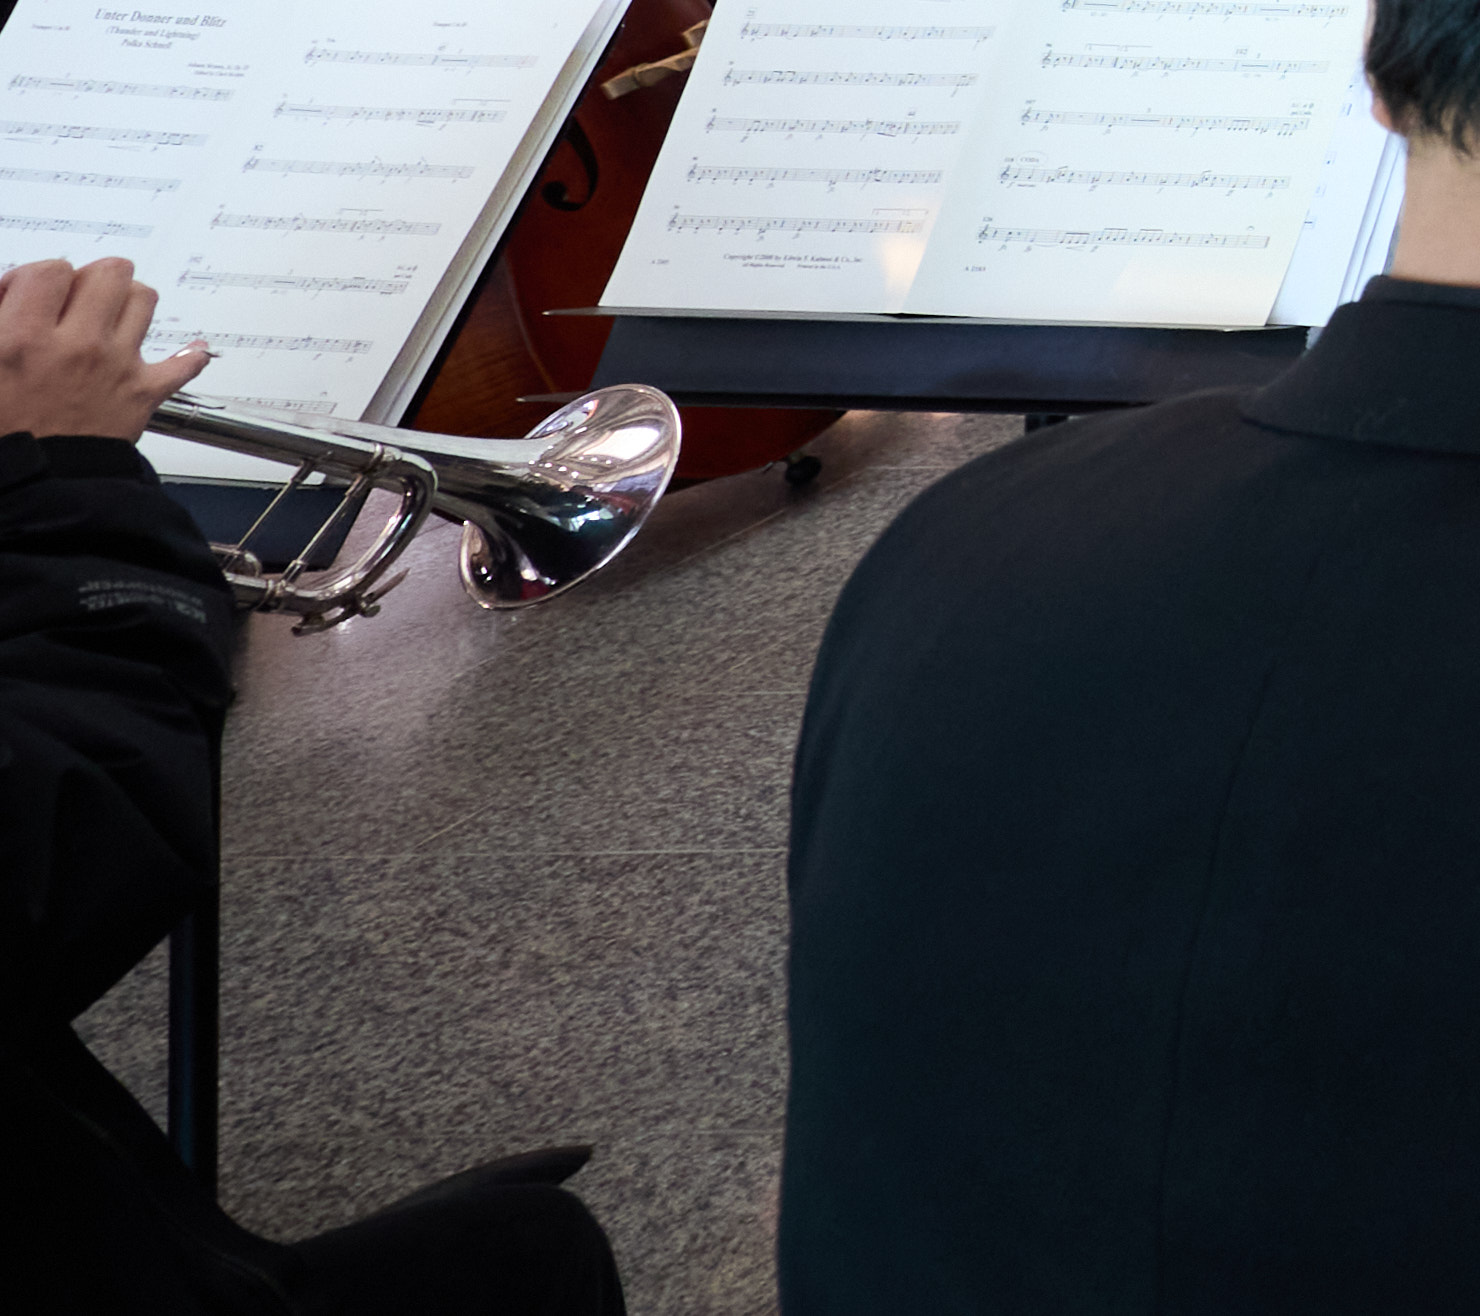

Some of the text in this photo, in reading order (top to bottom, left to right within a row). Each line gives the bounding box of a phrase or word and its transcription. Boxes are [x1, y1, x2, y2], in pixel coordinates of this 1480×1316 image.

[94, 8, 228, 28] Unter Donner und Blitz
